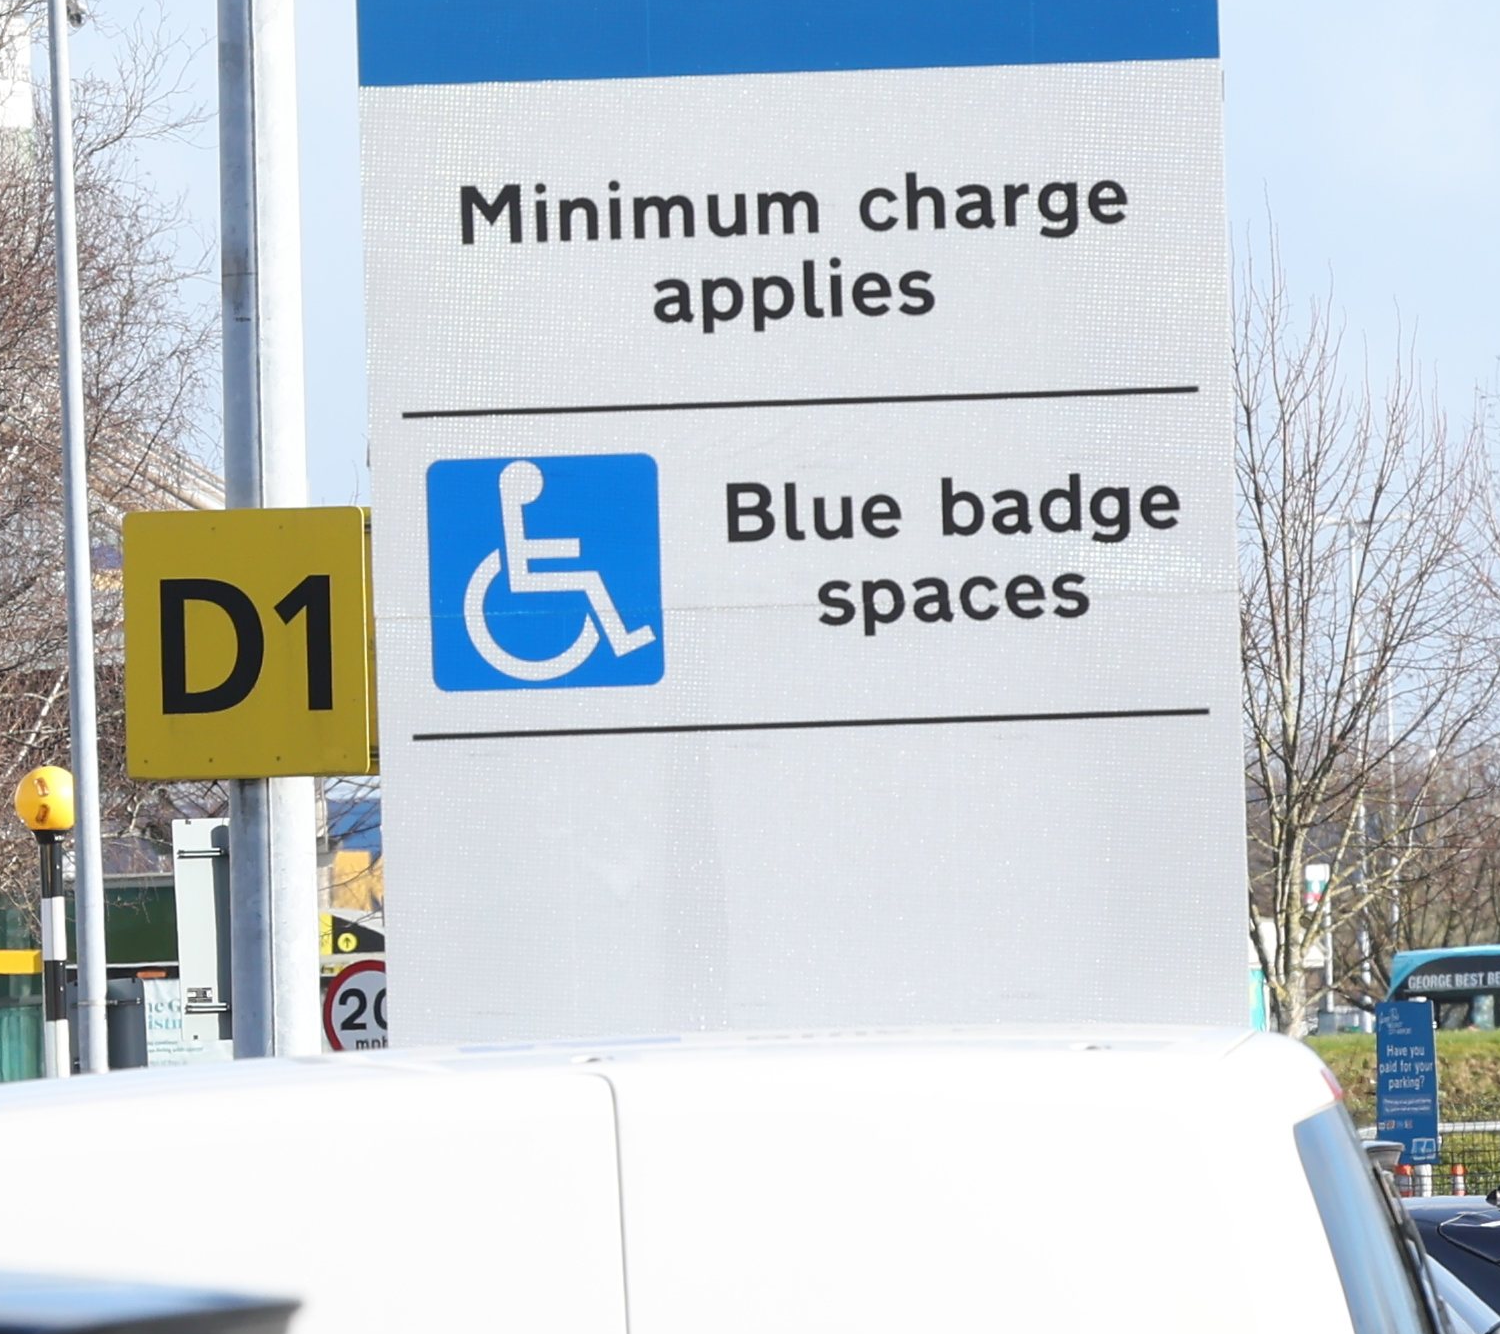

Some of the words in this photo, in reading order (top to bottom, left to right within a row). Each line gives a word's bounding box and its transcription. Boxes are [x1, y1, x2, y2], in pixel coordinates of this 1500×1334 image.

[460, 180, 820, 245] Minimum
[858, 172, 1129, 239] charge
[652, 257, 936, 334] applies
[725, 482, 903, 543] Blue
[940, 473, 1181, 543] badge
[817, 571, 1091, 636] spaces
[159, 574, 335, 716] D1
[1408, 973, 1452, 989] GEORGE
[1455, 972, 1484, 987] BEST
[1379, 1061, 1398, 1075] paid
[1400, 1060, 1412, 1072] for
[1415, 1061, 1433, 1075] your
[1387, 1044, 1407, 1057] Have
[1410, 1046, 1424, 1058] you
[1388, 1075, 1424, 1091] parking?
